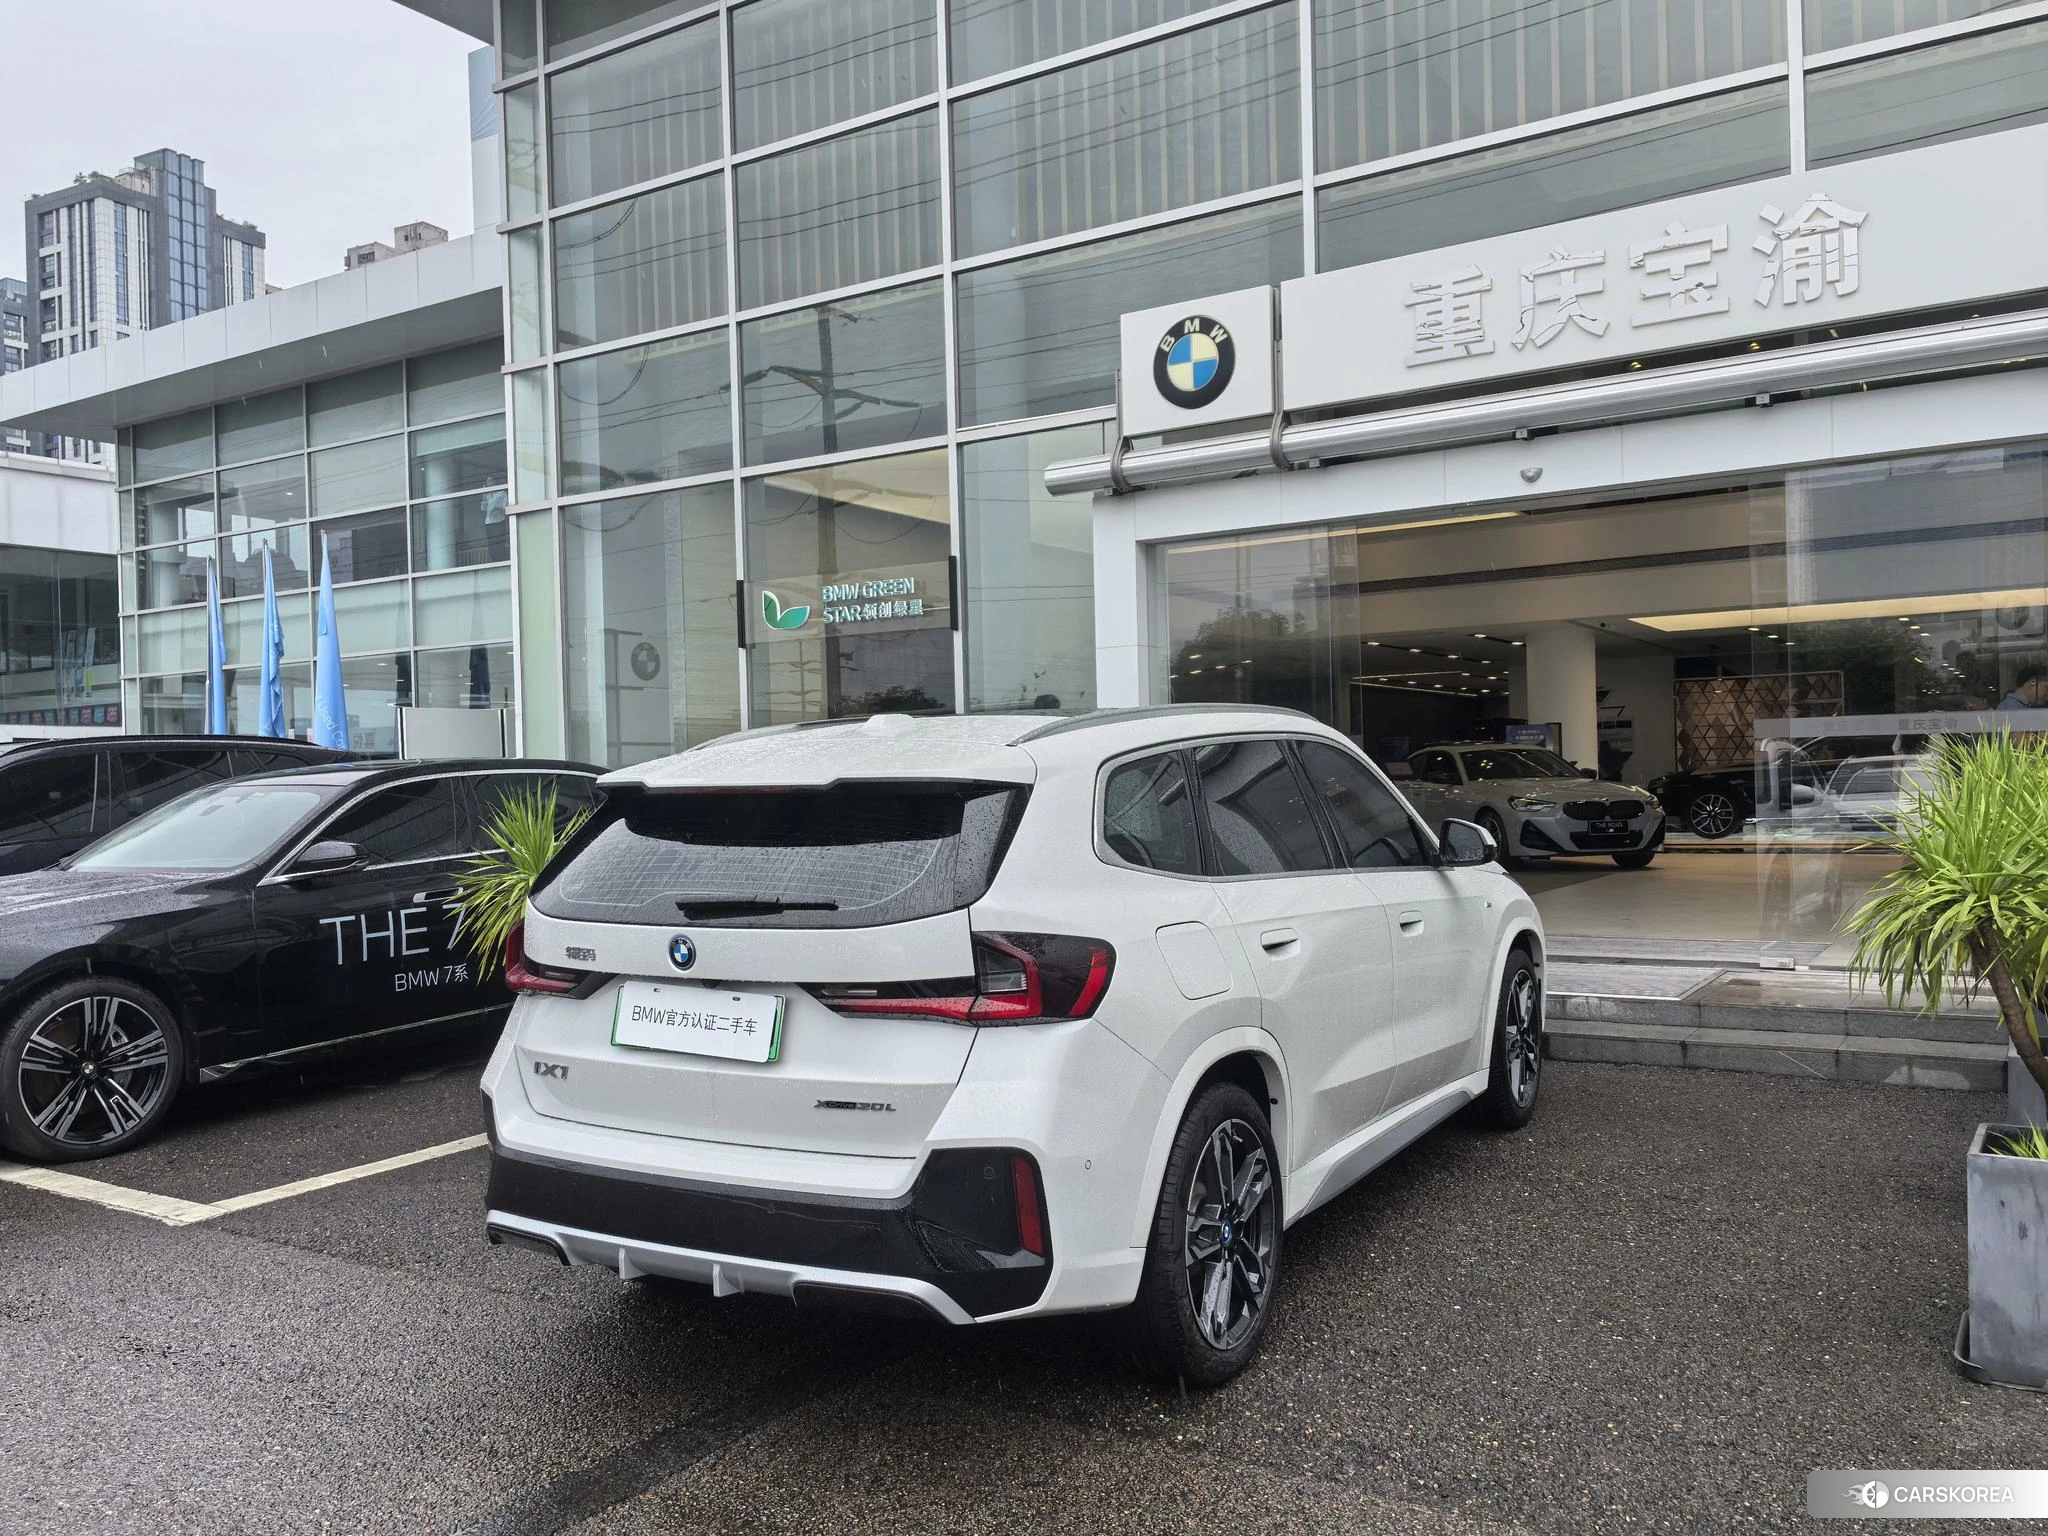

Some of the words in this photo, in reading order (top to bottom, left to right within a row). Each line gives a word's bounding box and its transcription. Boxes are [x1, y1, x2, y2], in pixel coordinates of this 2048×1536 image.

[1404, 192, 1869, 368] 重庆宝渝
[1159, 317, 1228, 353] BMW
[822, 583, 859, 602] BMW
[862, 577, 915, 598] GREEN
[823, 604, 861, 624] STAR
[319, 701, 338, 730] Used
[319, 907, 430, 965] THE
[394, 967, 439, 992] BMW
[443, 963, 469, 984] 7系
[631, 1005, 758, 1036] BMW官方认证二手车
